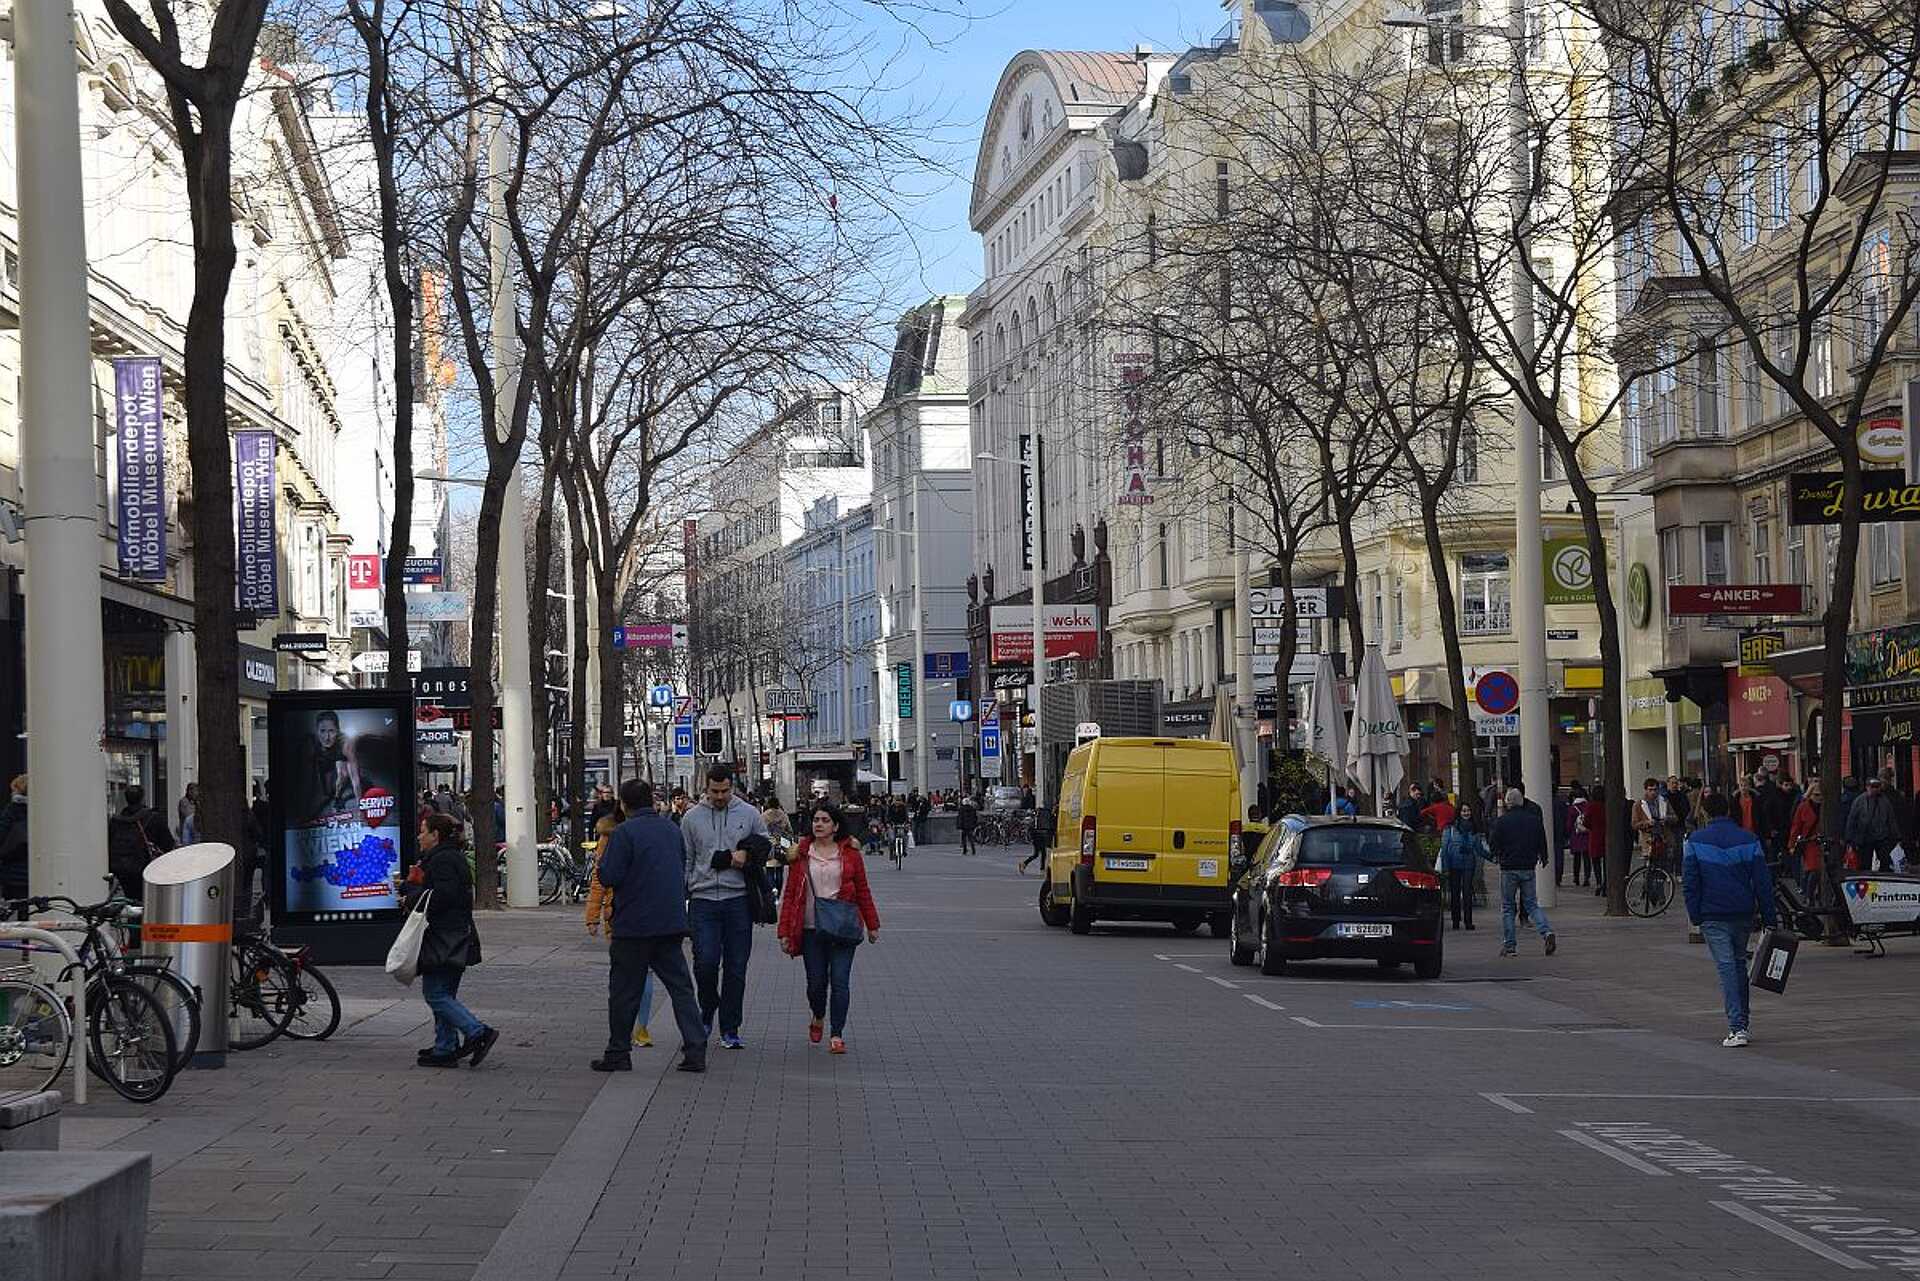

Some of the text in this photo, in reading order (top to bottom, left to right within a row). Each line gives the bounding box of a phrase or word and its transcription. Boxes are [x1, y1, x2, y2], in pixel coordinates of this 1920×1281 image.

[122, 394, 140, 571] Hofmobiliendepot
[140, 366, 160, 571] Möbel Museum Wien
[241, 460, 257, 609] Hofmobiliendepot
[255, 436, 274, 610] Möbel Museum Wien
[351, 560, 372, 583] T
[1713, 589, 1761, 601] ANKER
[655, 690, 669, 704] U
[899, 664, 912, 717] WEEKDAY
[956, 704, 970, 720] U
[1871, 892, 1920, 904] Printma
